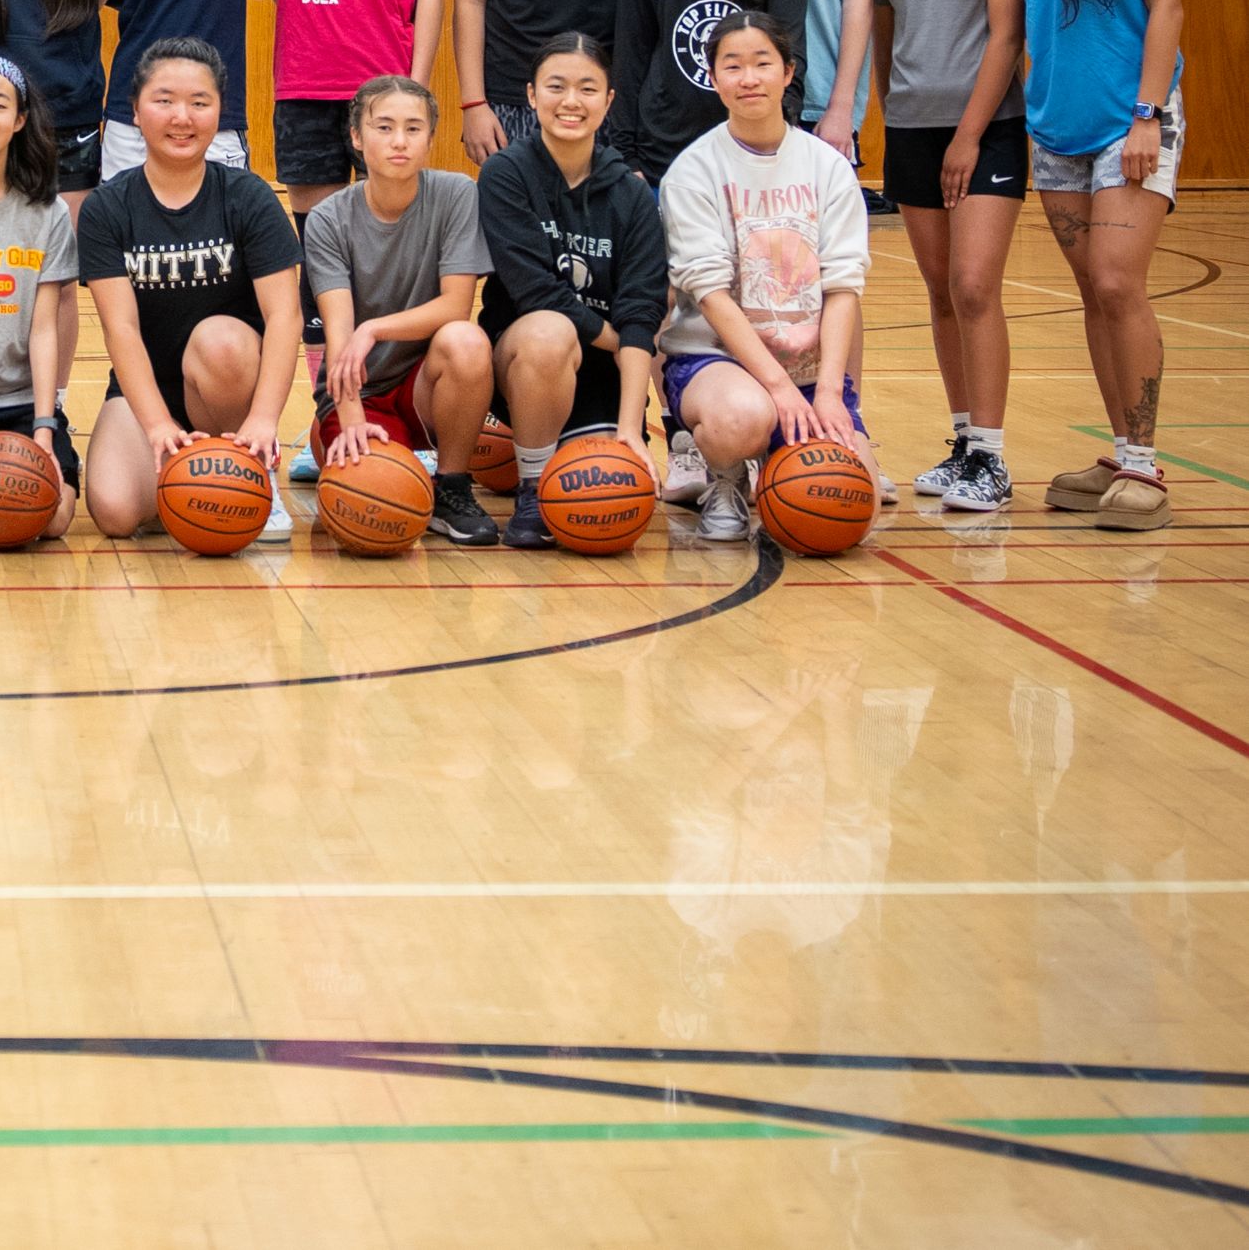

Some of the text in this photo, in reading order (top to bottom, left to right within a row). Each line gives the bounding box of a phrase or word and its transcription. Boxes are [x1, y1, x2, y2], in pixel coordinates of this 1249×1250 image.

[677, 3, 738, 35] TOP FLI
[540, 220, 613, 258] HKER
[124, 243, 235, 282] MITTY
[188, 457, 267, 490] Wilson
[558, 465, 638, 493] Wilson
[187, 497, 260, 518] EVOLUTION
[332, 498, 408, 538] SPALDING
[566, 506, 640, 526] EVOLUTION
